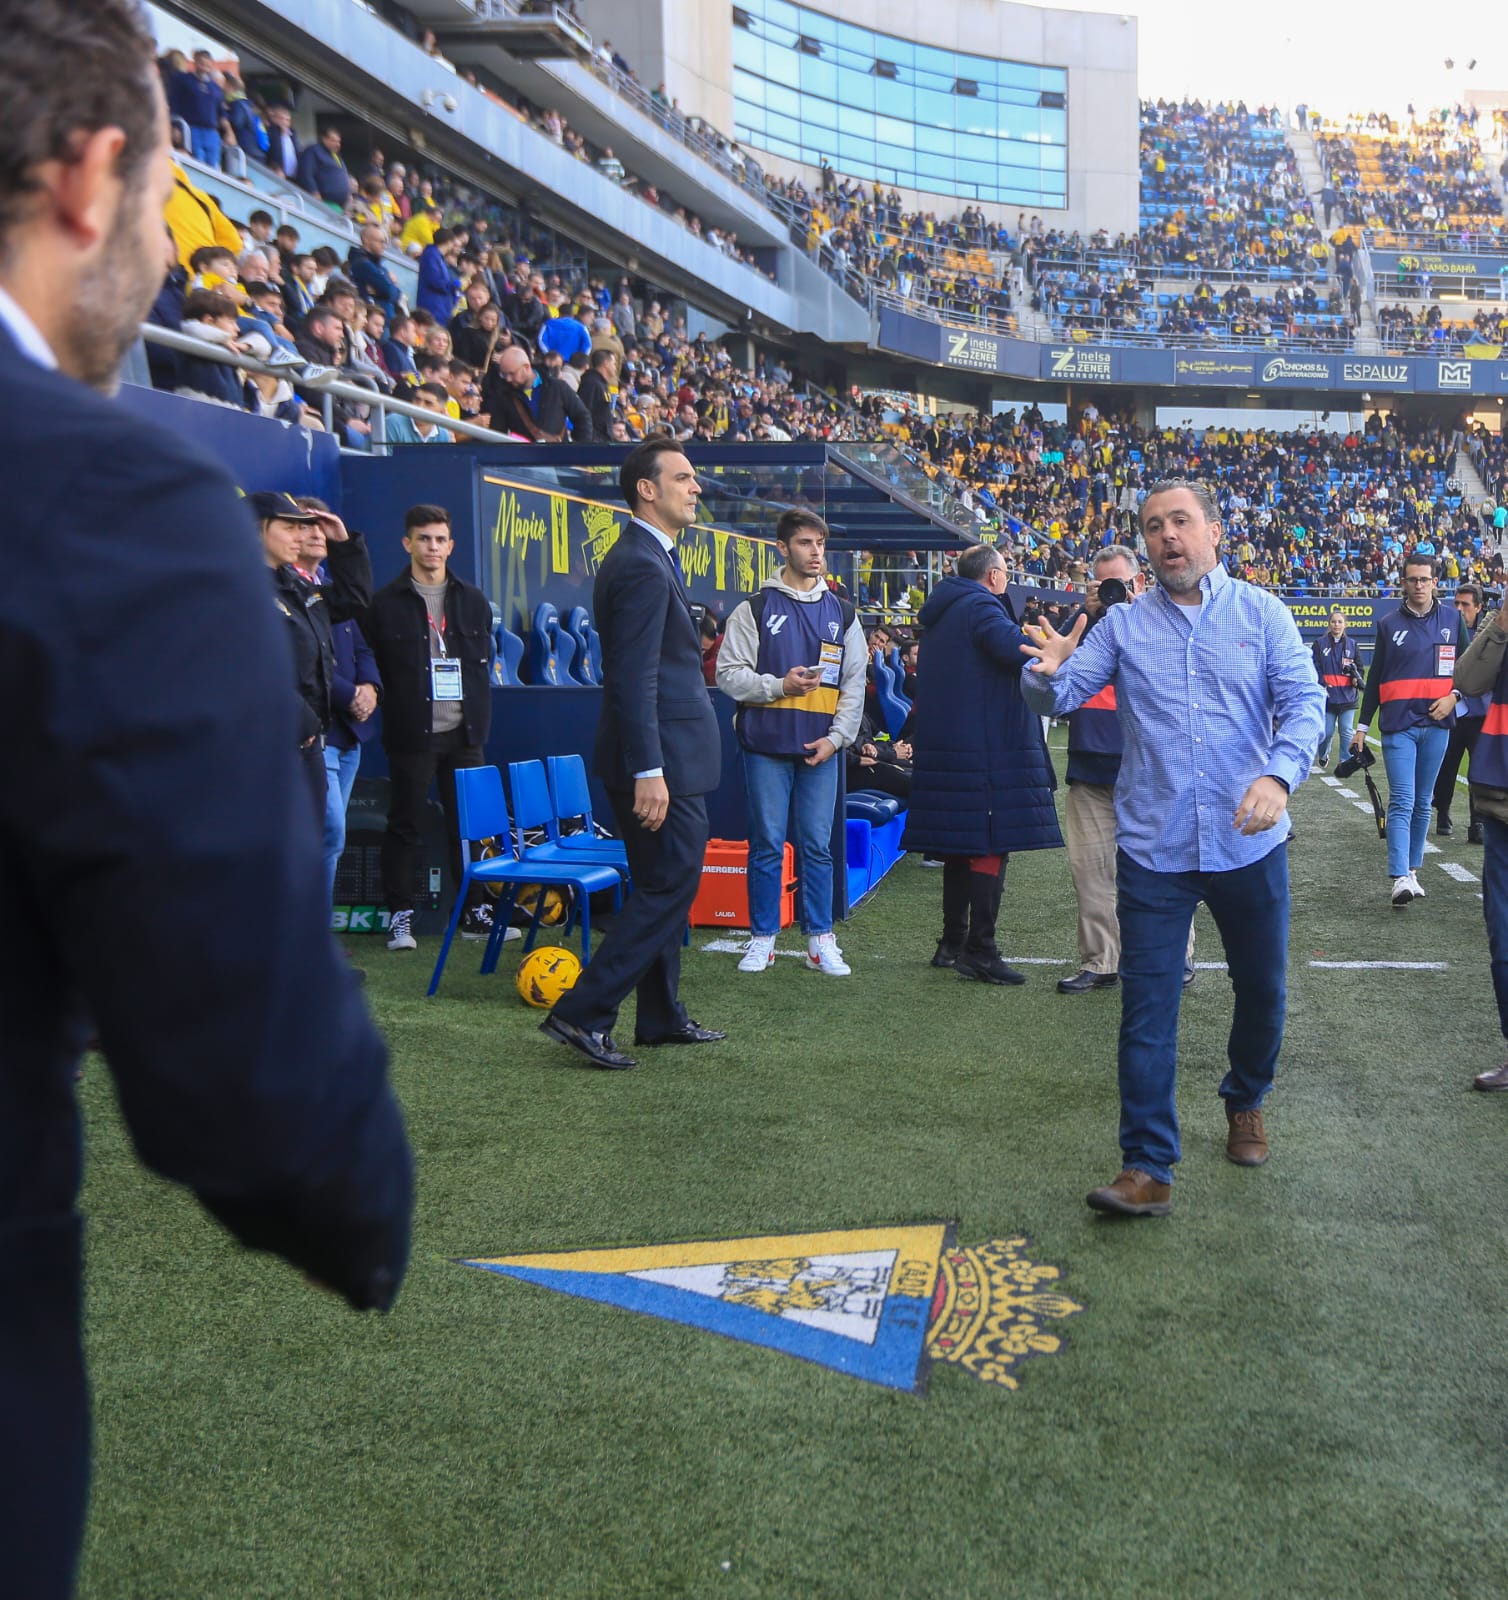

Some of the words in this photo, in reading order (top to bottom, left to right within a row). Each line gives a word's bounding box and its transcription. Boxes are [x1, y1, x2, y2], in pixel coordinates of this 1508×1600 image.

[970, 337, 998, 351] inelsa
[970, 351, 997, 364] ZENER
[1077, 351, 1111, 362] inelsa
[948, 357, 997, 370] ascensores
[1077, 363, 1111, 373] ZENER
[1284, 363, 1315, 371] CHICHOS
[1051, 371, 1111, 380] ascensores
[1344, 364, 1408, 380] ESPALUZ
[1287, 605, 1328, 616] TACA
[1304, 619, 1329, 628] SEAFO
[701, 865, 748, 874] MERGENCI
